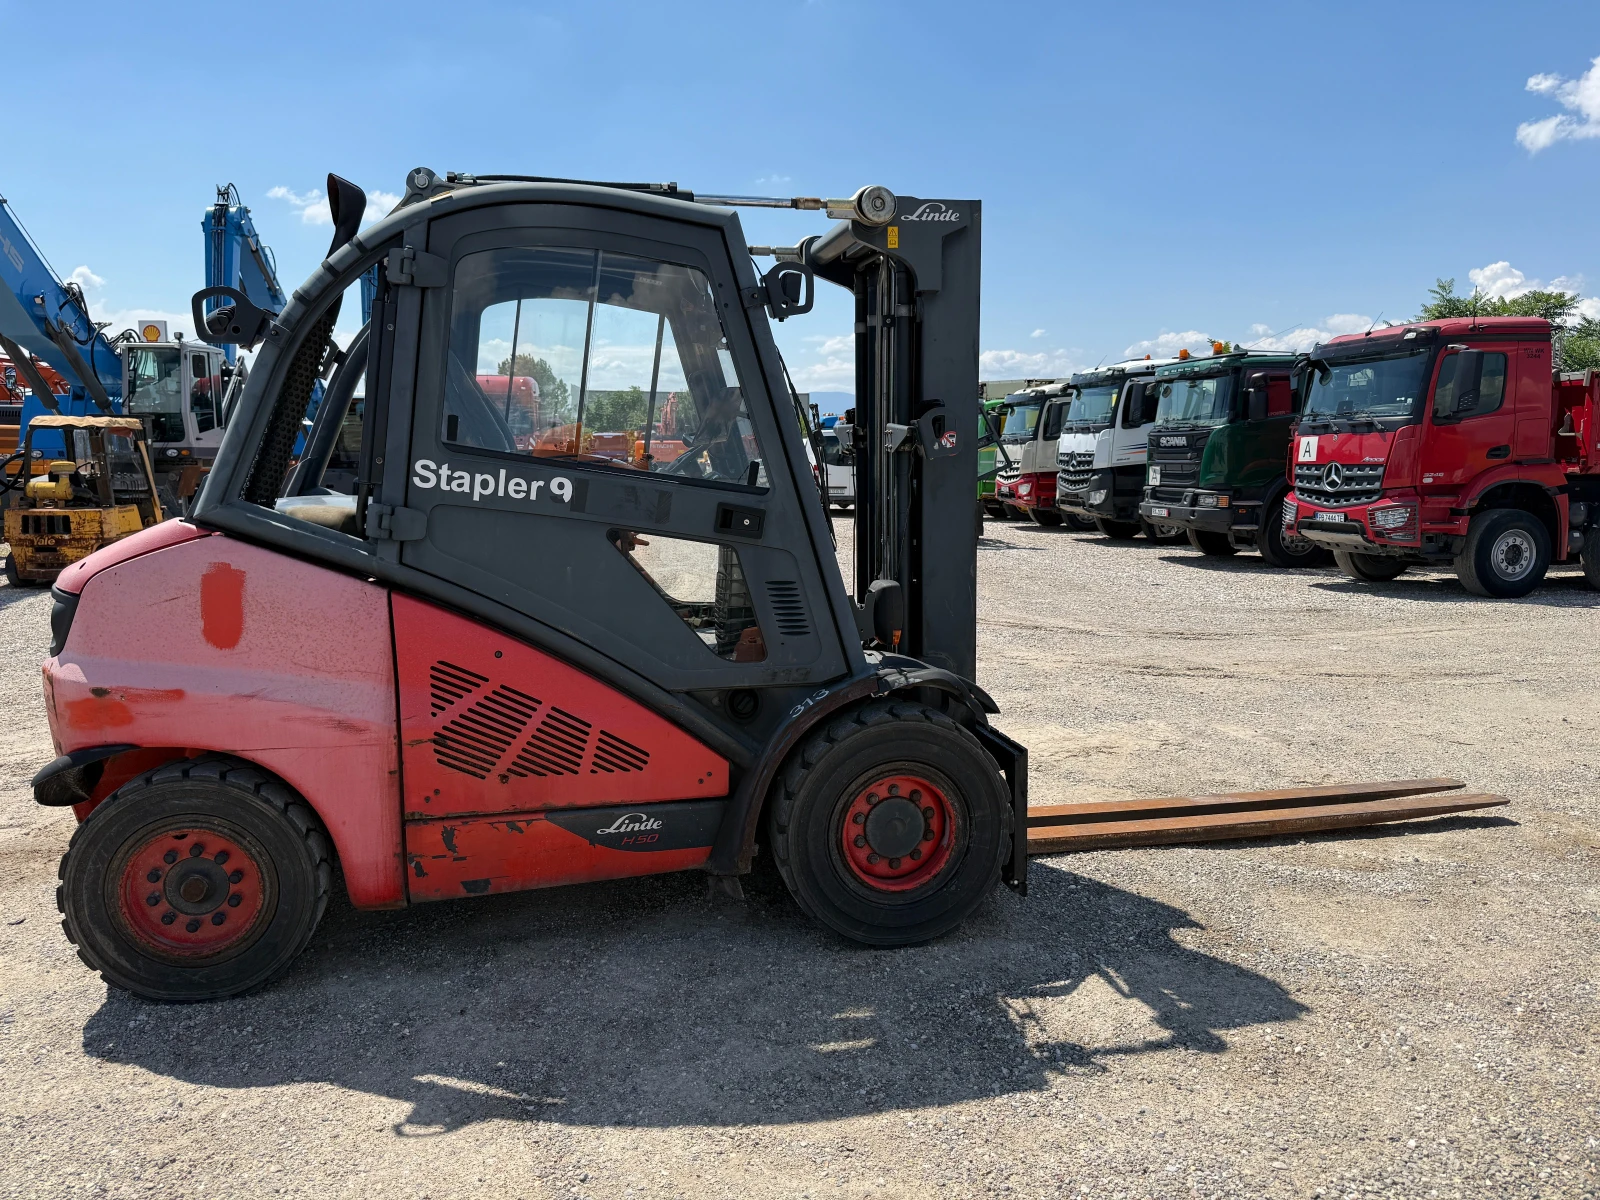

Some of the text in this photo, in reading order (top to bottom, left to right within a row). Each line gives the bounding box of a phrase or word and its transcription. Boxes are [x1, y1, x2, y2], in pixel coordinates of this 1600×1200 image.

[901, 202, 960, 222] Linde
[1159, 436, 1187, 447] SCANIA
[1302, 440, 1312, 458] A
[412, 459, 573, 503] Stapler 9
[1150, 468, 1158, 483] A
[33, 535, 56, 546] Yale
[789, 688, 830, 718] 313
[596, 812, 663, 835] Linde
